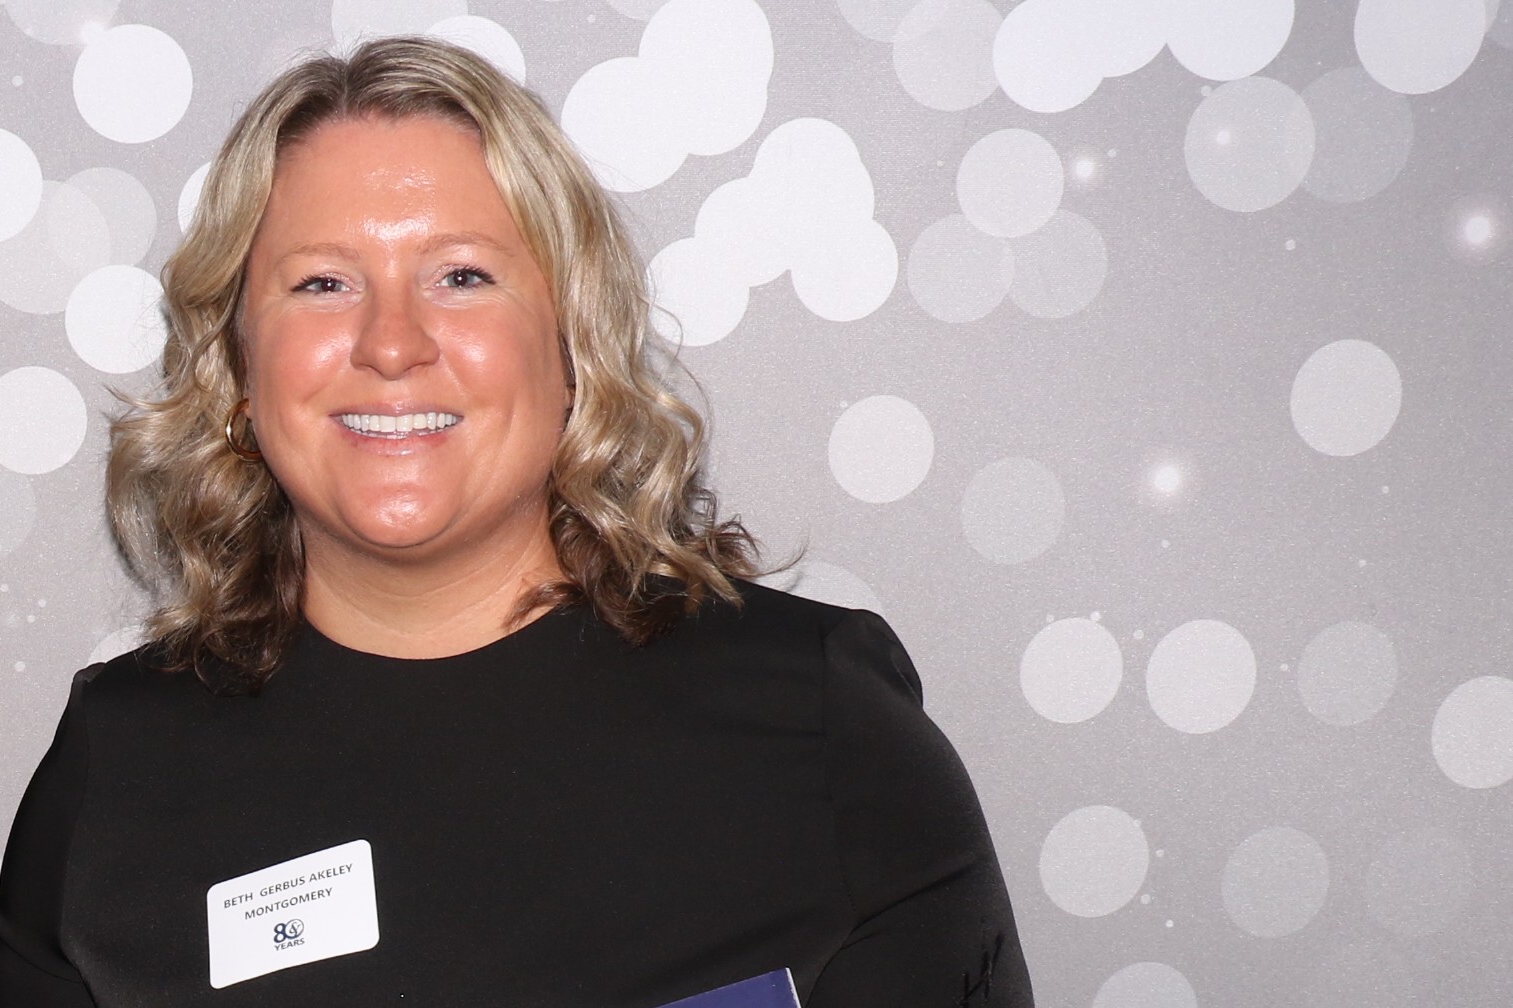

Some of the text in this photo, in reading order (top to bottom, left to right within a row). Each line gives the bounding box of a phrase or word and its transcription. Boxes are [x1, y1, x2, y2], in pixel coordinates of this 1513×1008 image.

[223, 863, 353, 909] BETH GERBUS AKELEY
[244, 887, 333, 920] MONTGOMERY
[274, 938, 305, 951] YEARS
